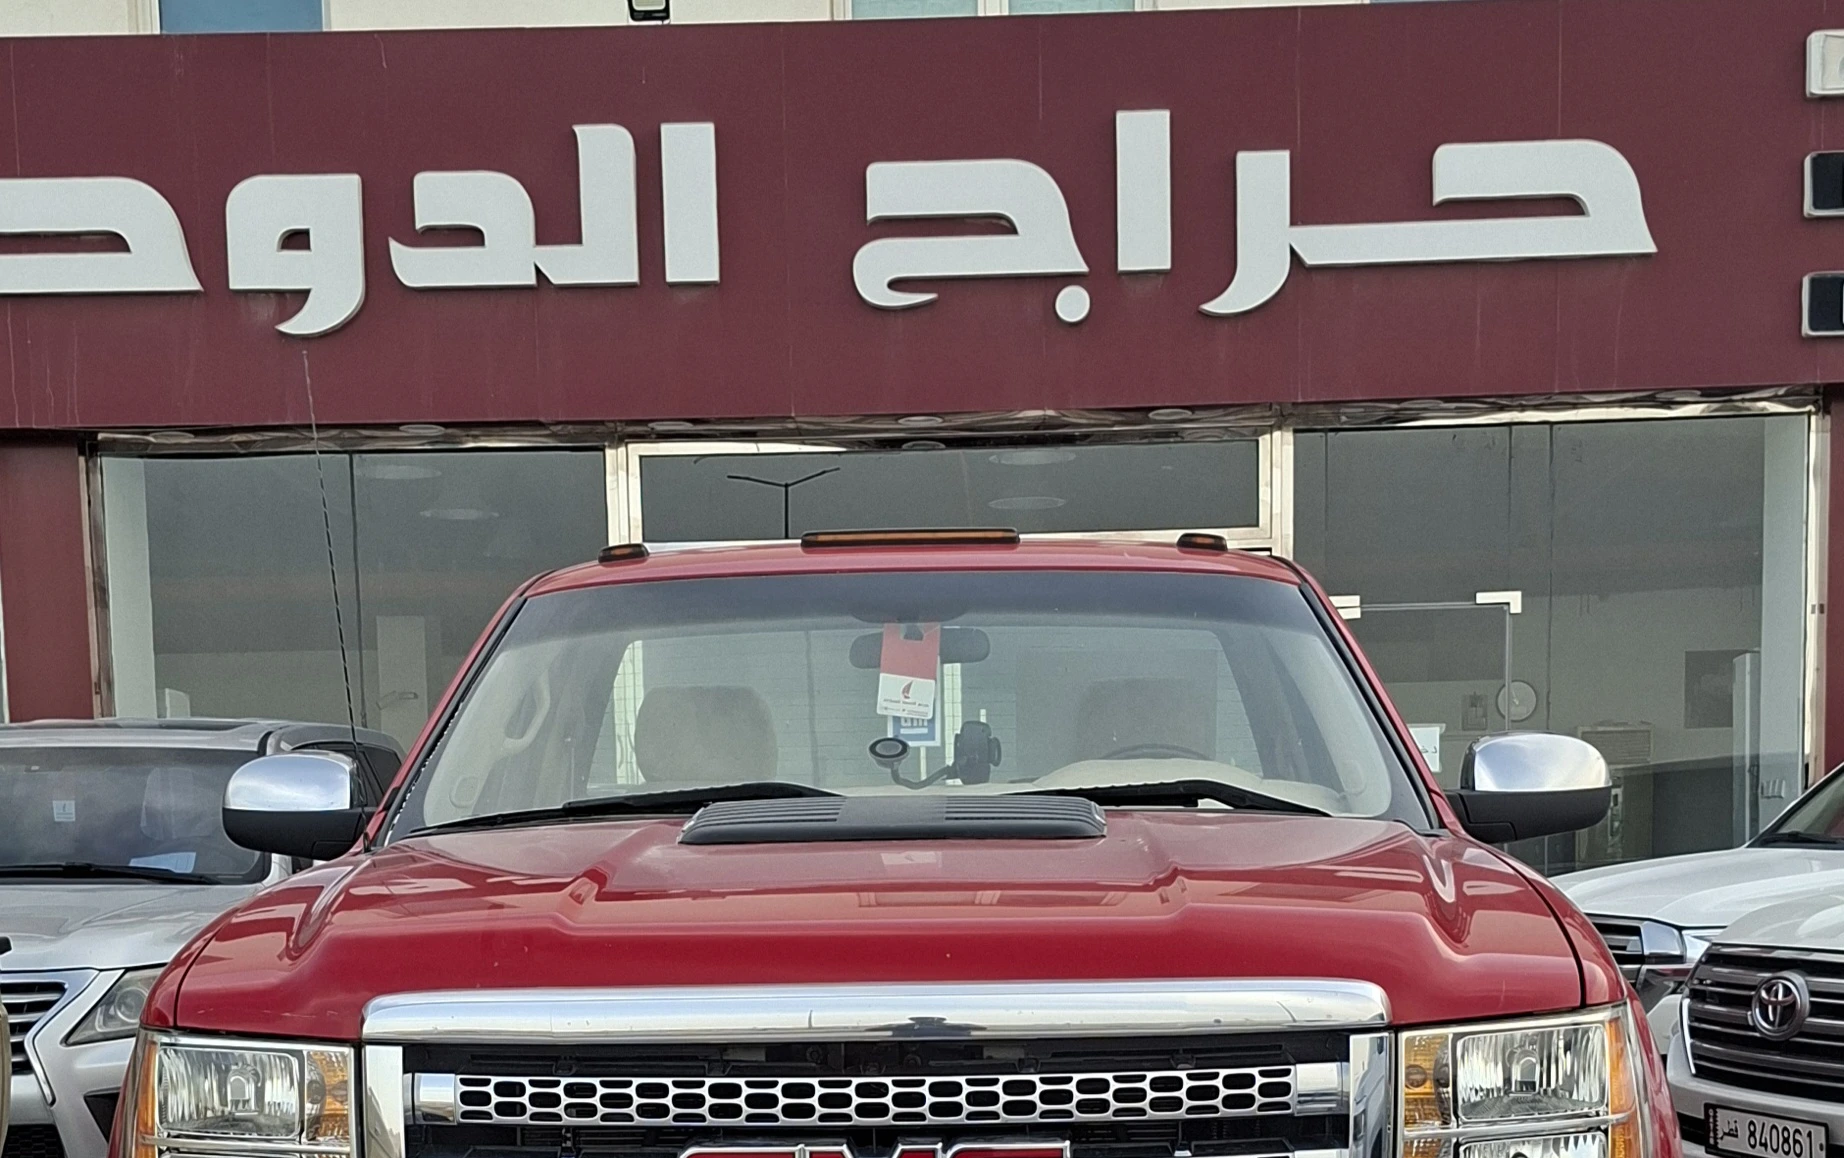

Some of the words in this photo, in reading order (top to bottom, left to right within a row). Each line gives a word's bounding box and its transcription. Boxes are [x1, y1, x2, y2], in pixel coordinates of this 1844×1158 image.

[0, 122, 720, 337] الدوح
[852, 109, 1658, 324] حراج
[1719, 1119, 1739, 1141] قطر
